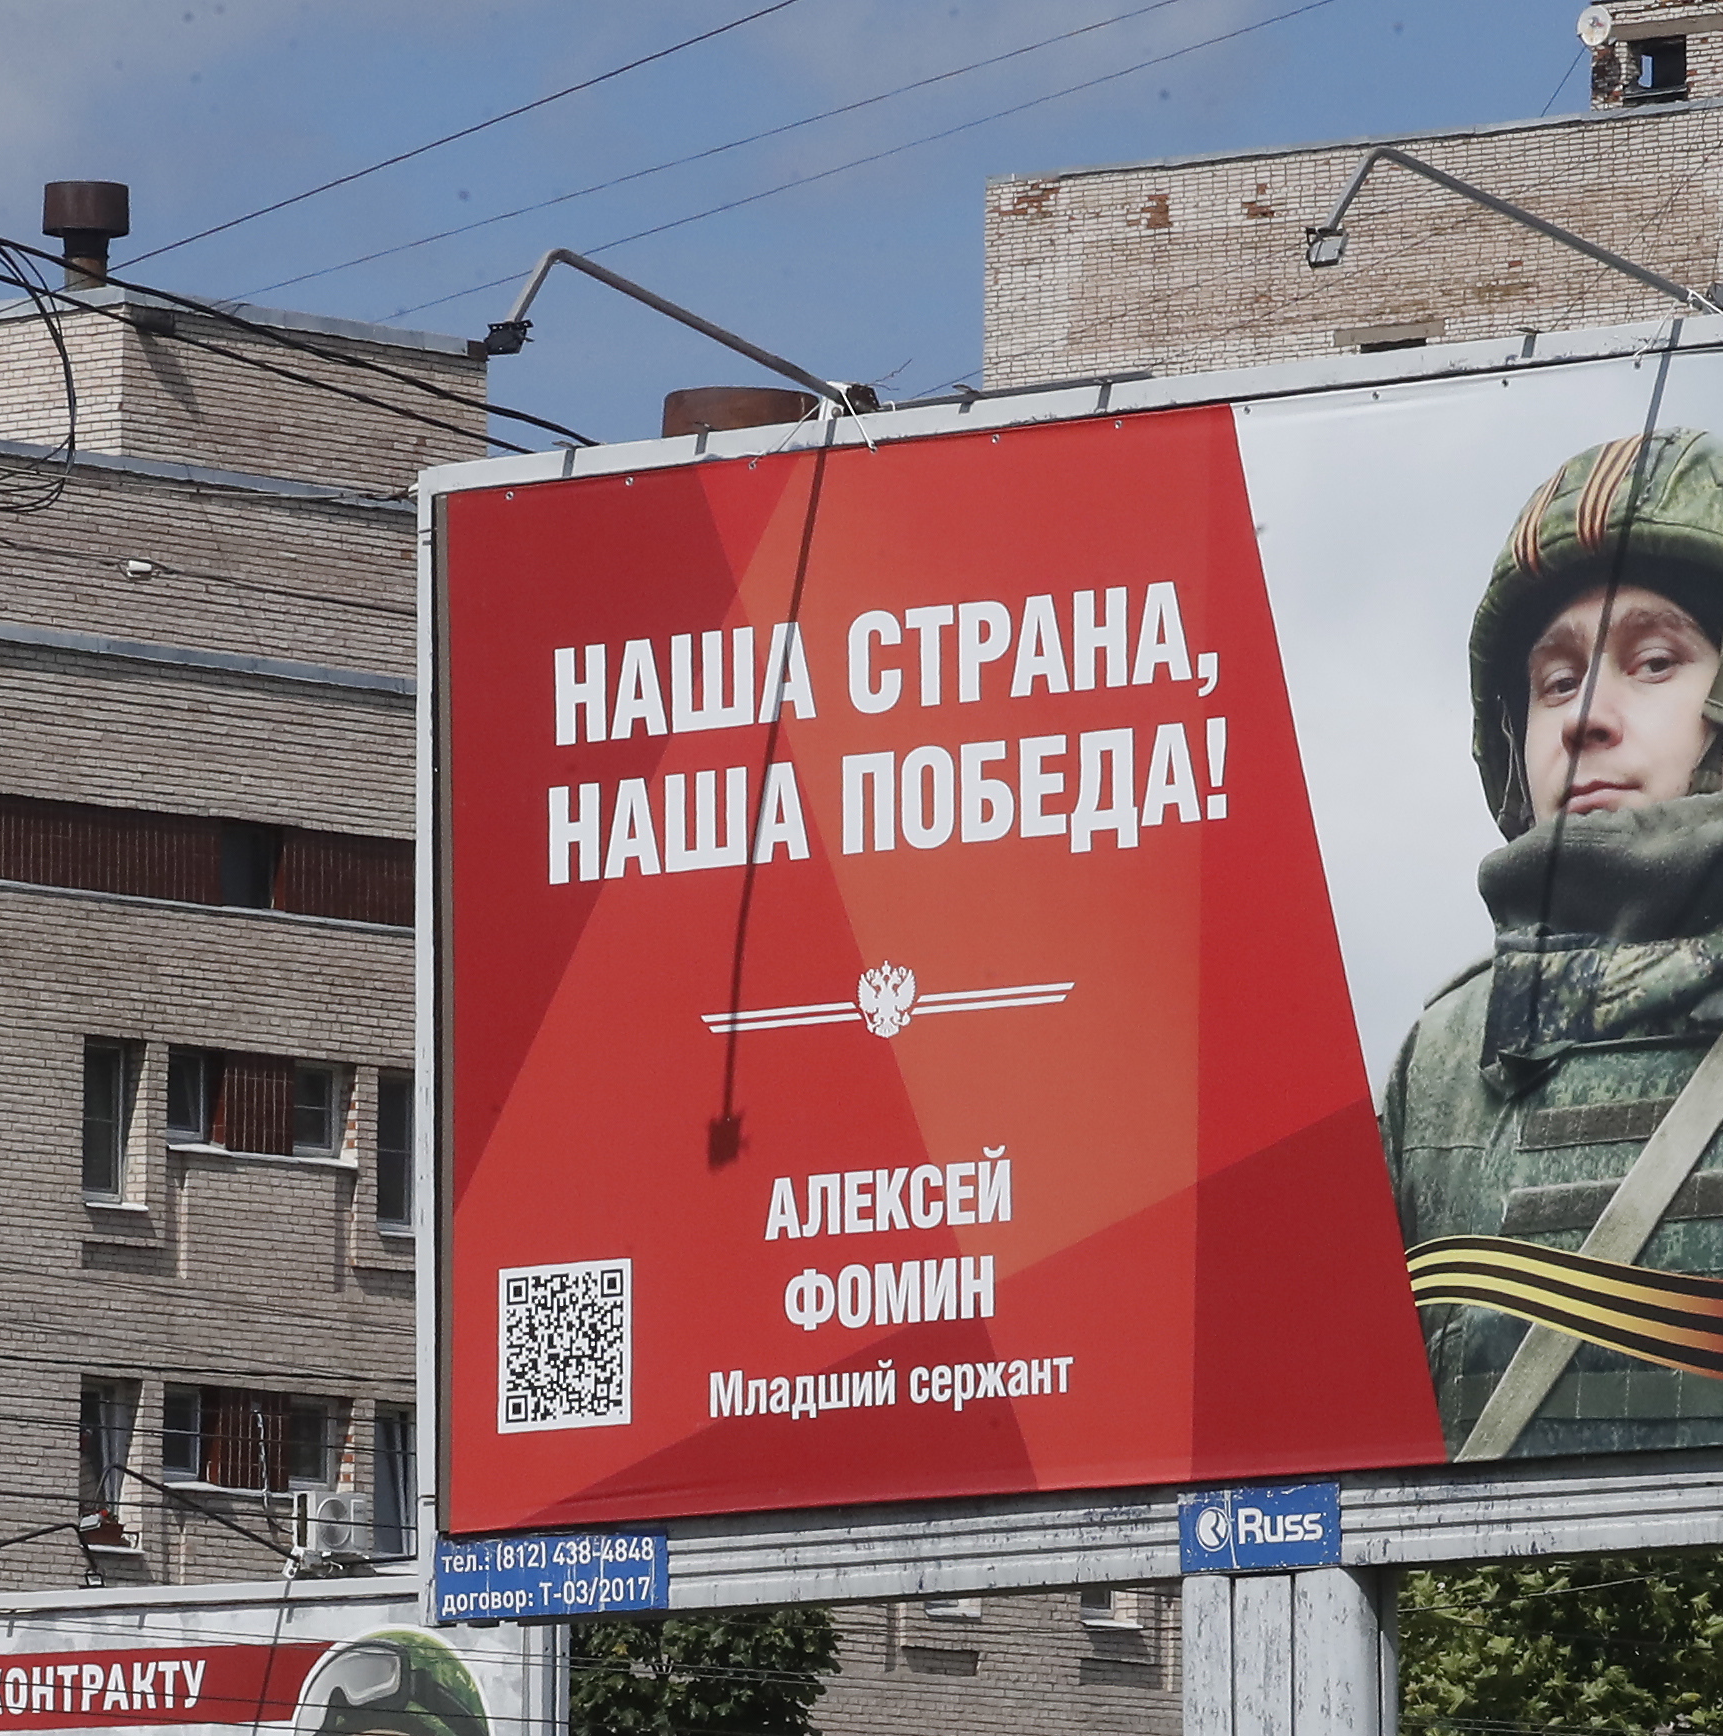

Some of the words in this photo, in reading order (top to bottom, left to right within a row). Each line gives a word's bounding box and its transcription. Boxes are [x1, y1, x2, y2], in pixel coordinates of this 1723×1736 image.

[554, 621, 817, 746] НАША
[847, 581, 1219, 714] СТРАНА,
[547, 761, 810, 885] НАША
[841, 716, 1228, 855] ПОБЕДА!
[764, 1145, 1012, 1241] АЛЕКСЕЙ
[784, 1255, 995, 1331] ФОМИН
[709, 1359, 896, 1420] Младший
[909, 1356, 1074, 1411] сержант
[441, 1553, 490, 1573] тел.:
[496, 1541, 546, 1569] (812)
[552, 1537, 654, 1565] 438-4848
[1238, 1507, 1323, 1544] Russ
[442, 1589, 534, 1616] договор:
